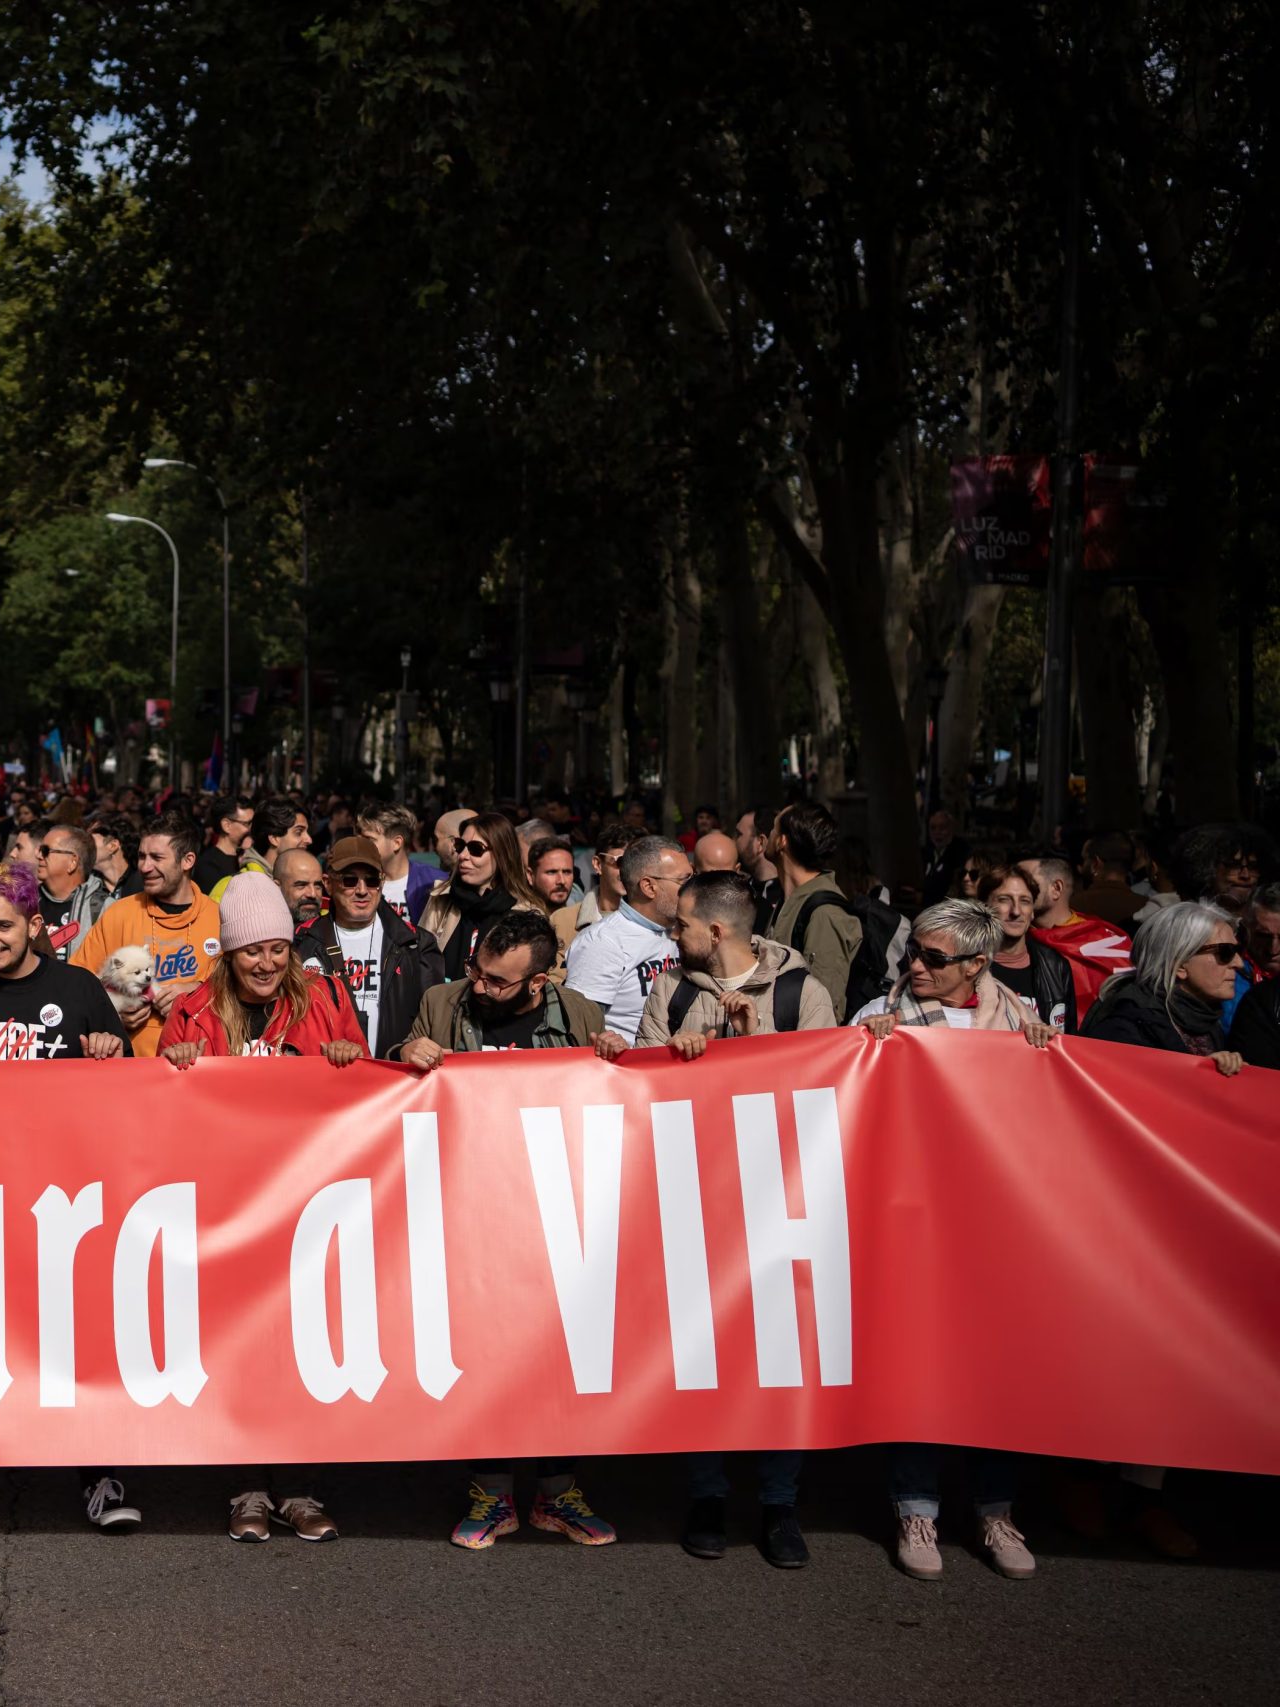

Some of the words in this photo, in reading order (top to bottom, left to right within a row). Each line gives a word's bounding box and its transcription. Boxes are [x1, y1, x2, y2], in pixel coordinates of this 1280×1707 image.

[960, 515, 1000, 532] LUZ
[987, 530, 1032, 547] MAD
[974, 544, 1007, 560] RID
[289, 1111, 464, 1402] al
[519, 1086, 853, 1395] VIH
